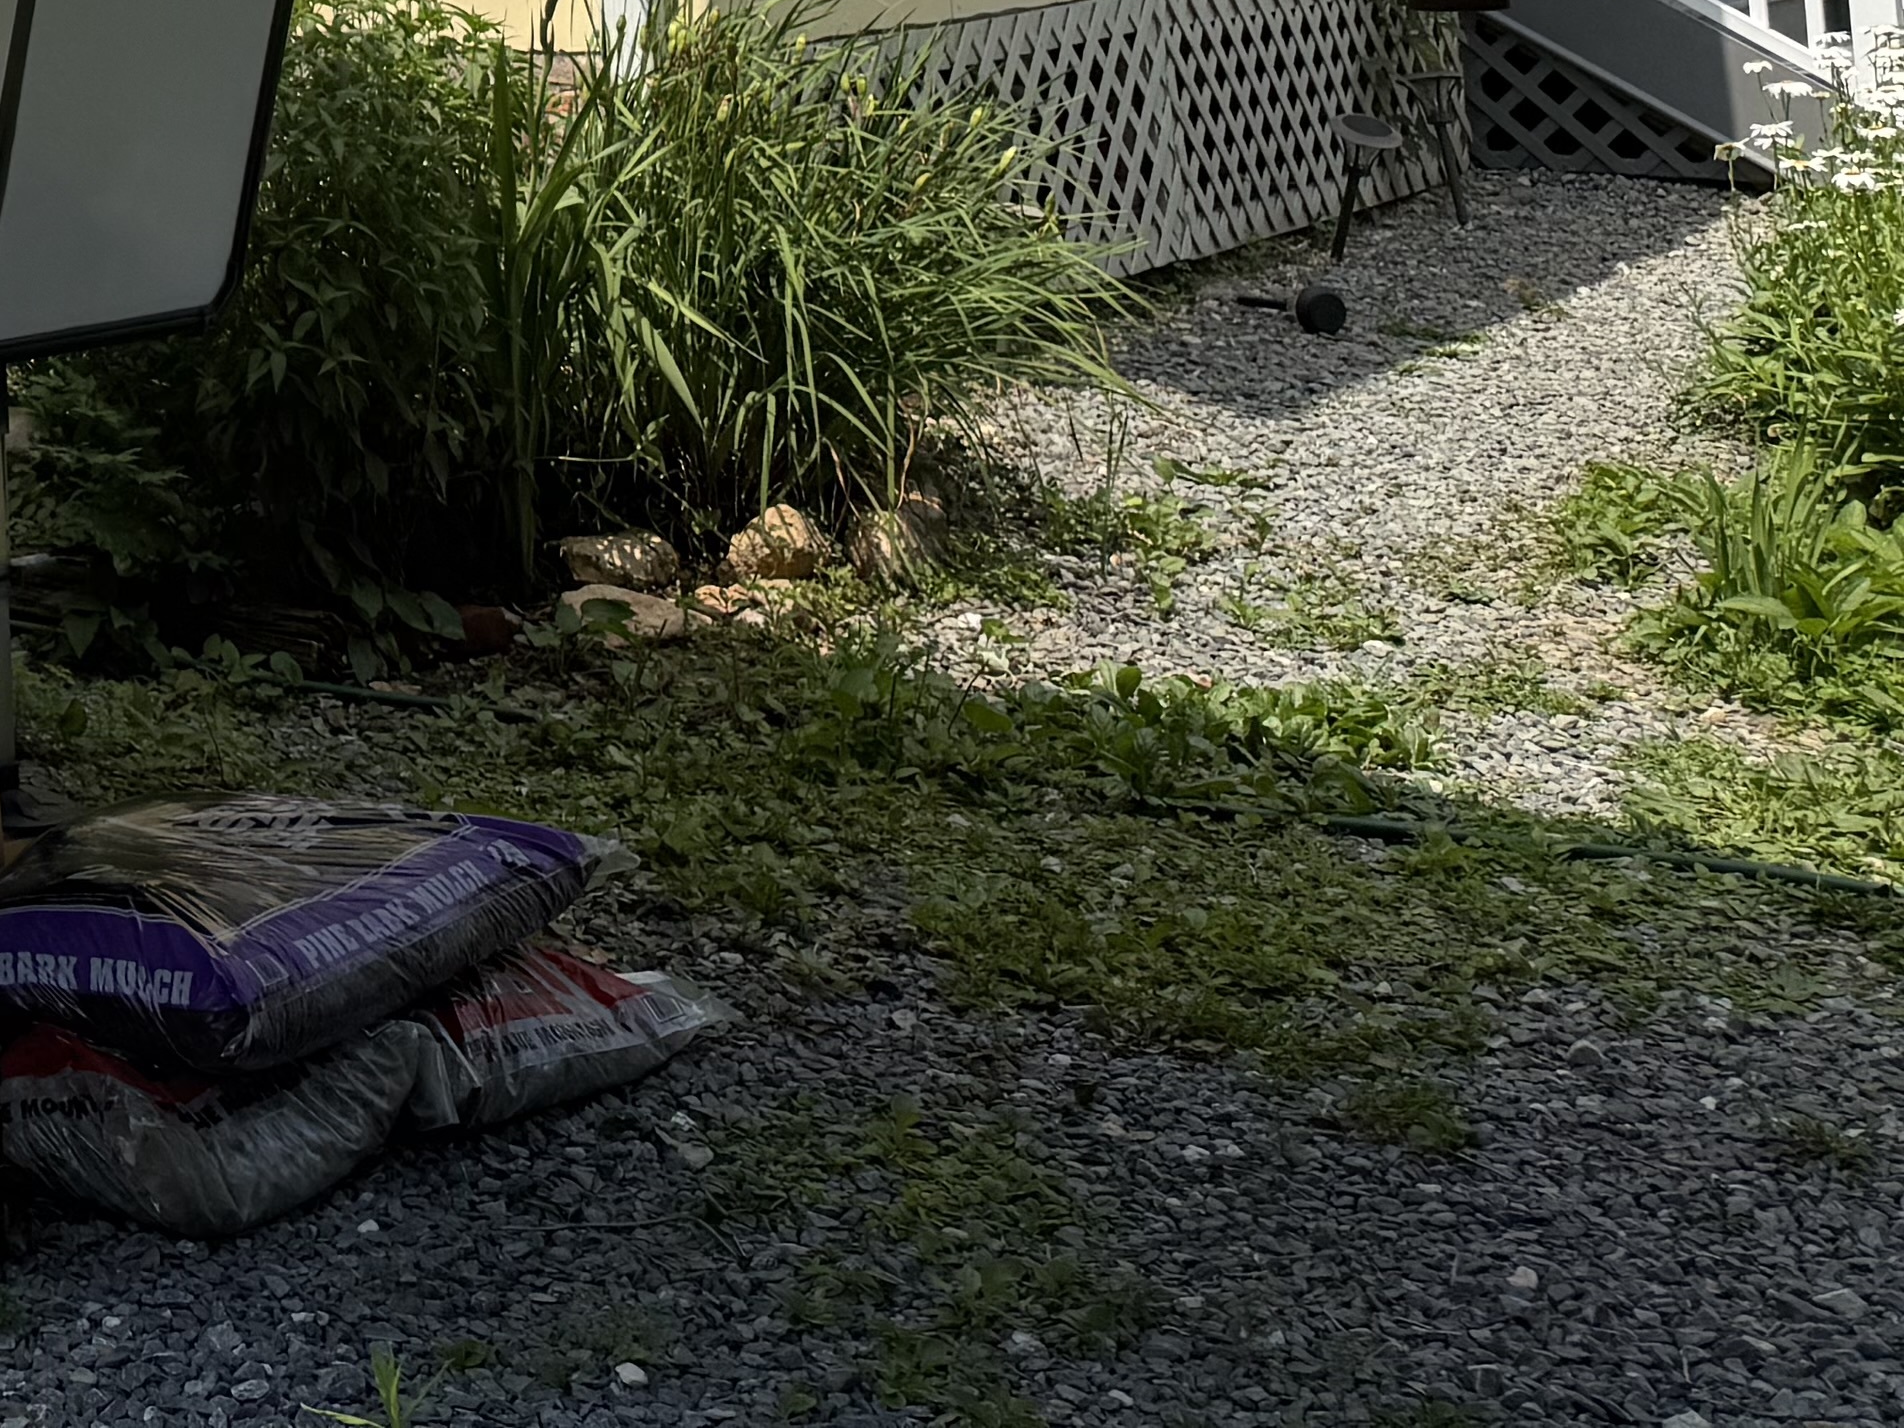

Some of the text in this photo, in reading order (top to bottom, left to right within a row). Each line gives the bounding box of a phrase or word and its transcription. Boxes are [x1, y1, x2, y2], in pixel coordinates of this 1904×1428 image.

[294, 923, 360, 969] PINE
[406, 860, 490, 915] MULCH
[89, 956, 194, 1006] MULCH
